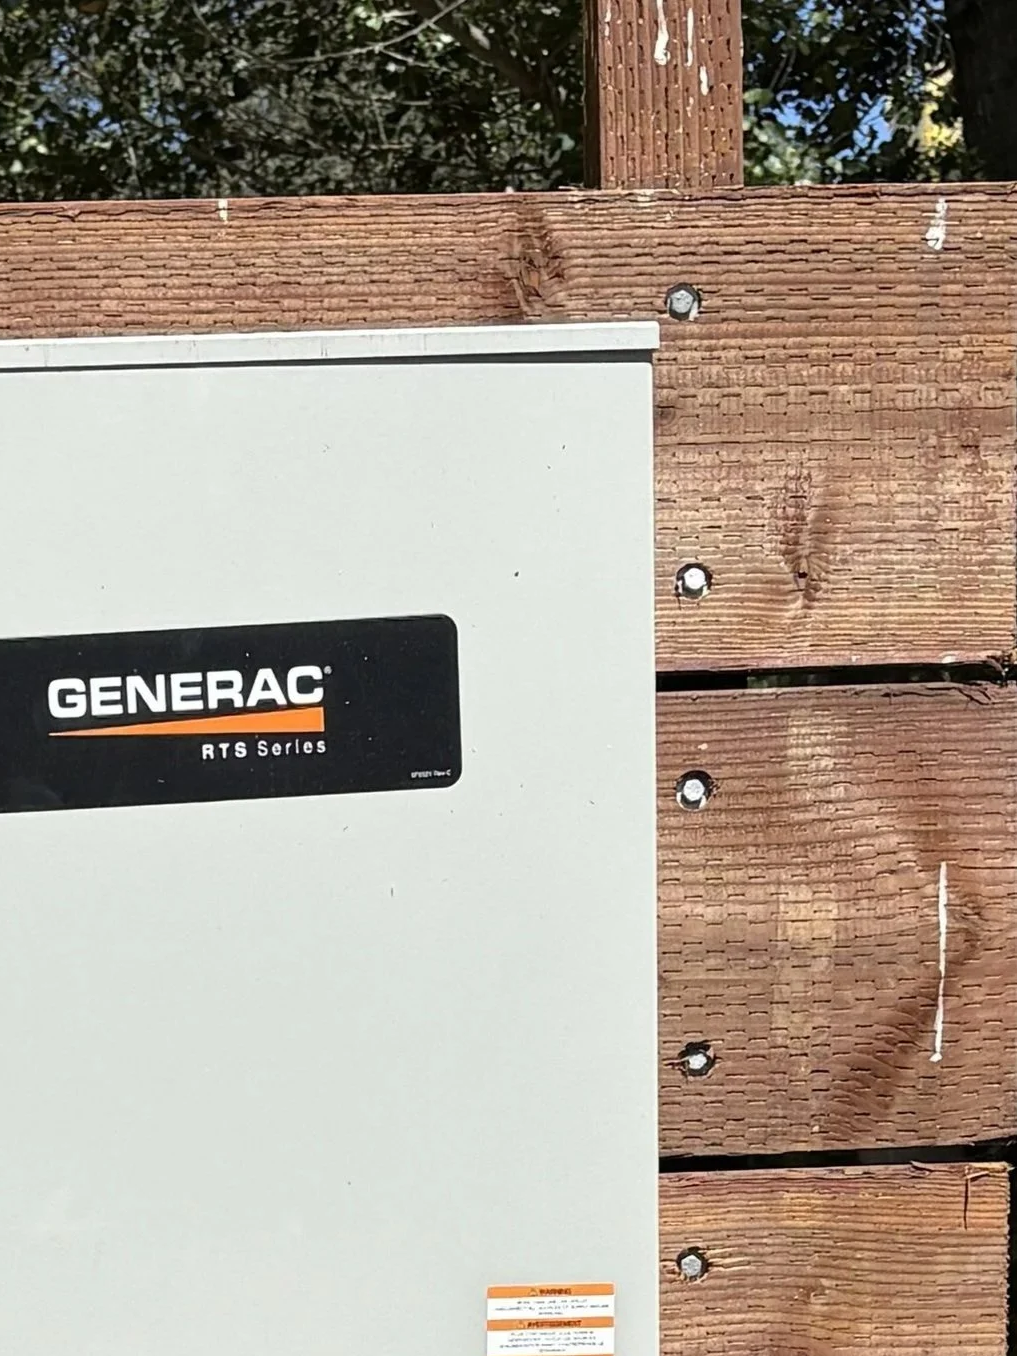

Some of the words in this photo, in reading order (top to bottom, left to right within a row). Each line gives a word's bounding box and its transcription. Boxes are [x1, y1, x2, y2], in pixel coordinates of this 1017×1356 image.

[48, 665, 324, 718] GENERAC
[202, 741, 247, 760] RTS
[257, 739, 326, 756] Series
